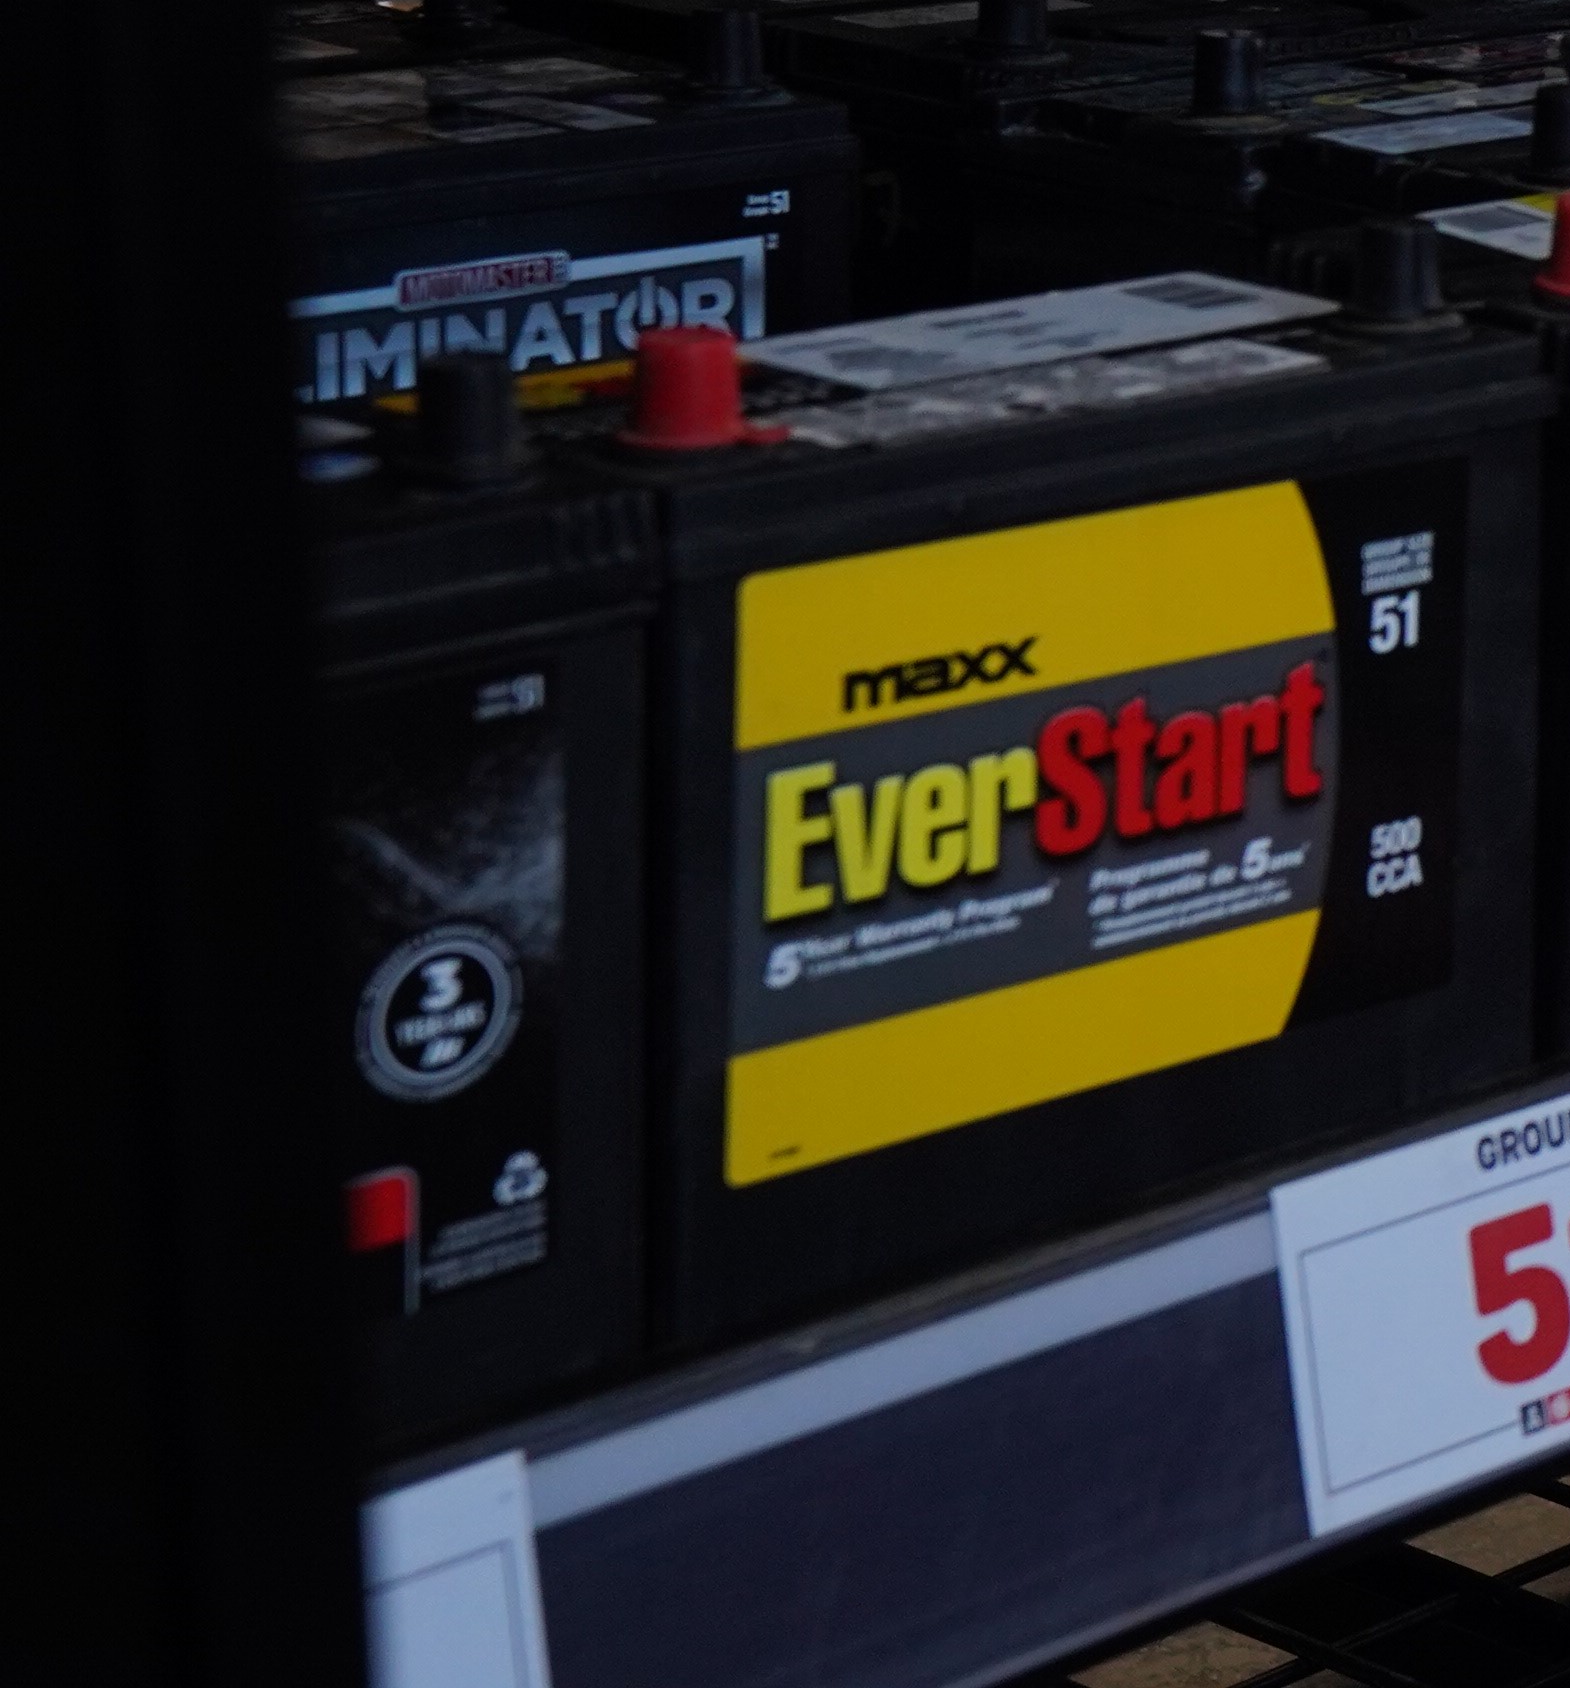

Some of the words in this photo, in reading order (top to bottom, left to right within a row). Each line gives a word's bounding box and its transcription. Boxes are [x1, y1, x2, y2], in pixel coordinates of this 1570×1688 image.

[1368, 589, 1419, 654] 51
[843, 636, 1038, 713] maxx
[764, 659, 1327, 925] EverStart
[1241, 837, 1271, 880] 5
[1371, 815, 1422, 861] 500
[1366, 855, 1424, 899] CCA
[763, 940, 802, 991] 5
